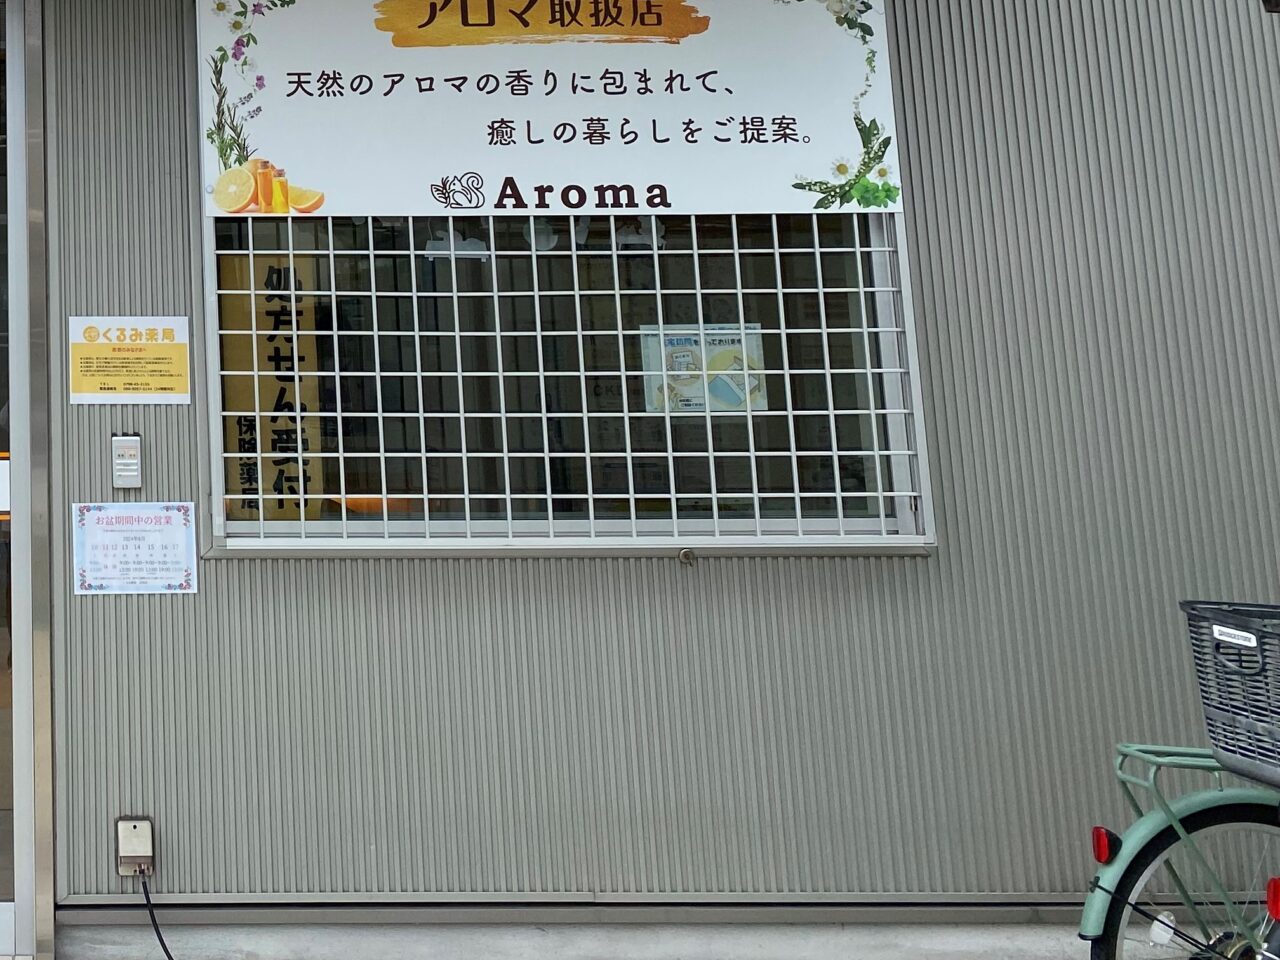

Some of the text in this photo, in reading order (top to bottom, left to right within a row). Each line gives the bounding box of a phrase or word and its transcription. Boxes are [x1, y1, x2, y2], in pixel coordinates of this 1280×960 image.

[285, 66, 737, 100] 天然のアロマの香りに包まれて、
[485, 114, 815, 148] 癒しの暮らしをご提案。
[492, 176, 672, 210] Aroma
[102, 327, 176, 343] くるみ薬局
[264, 265, 311, 510] 処方せん受付
[95, 515, 173, 526] お盆期間中の営業
